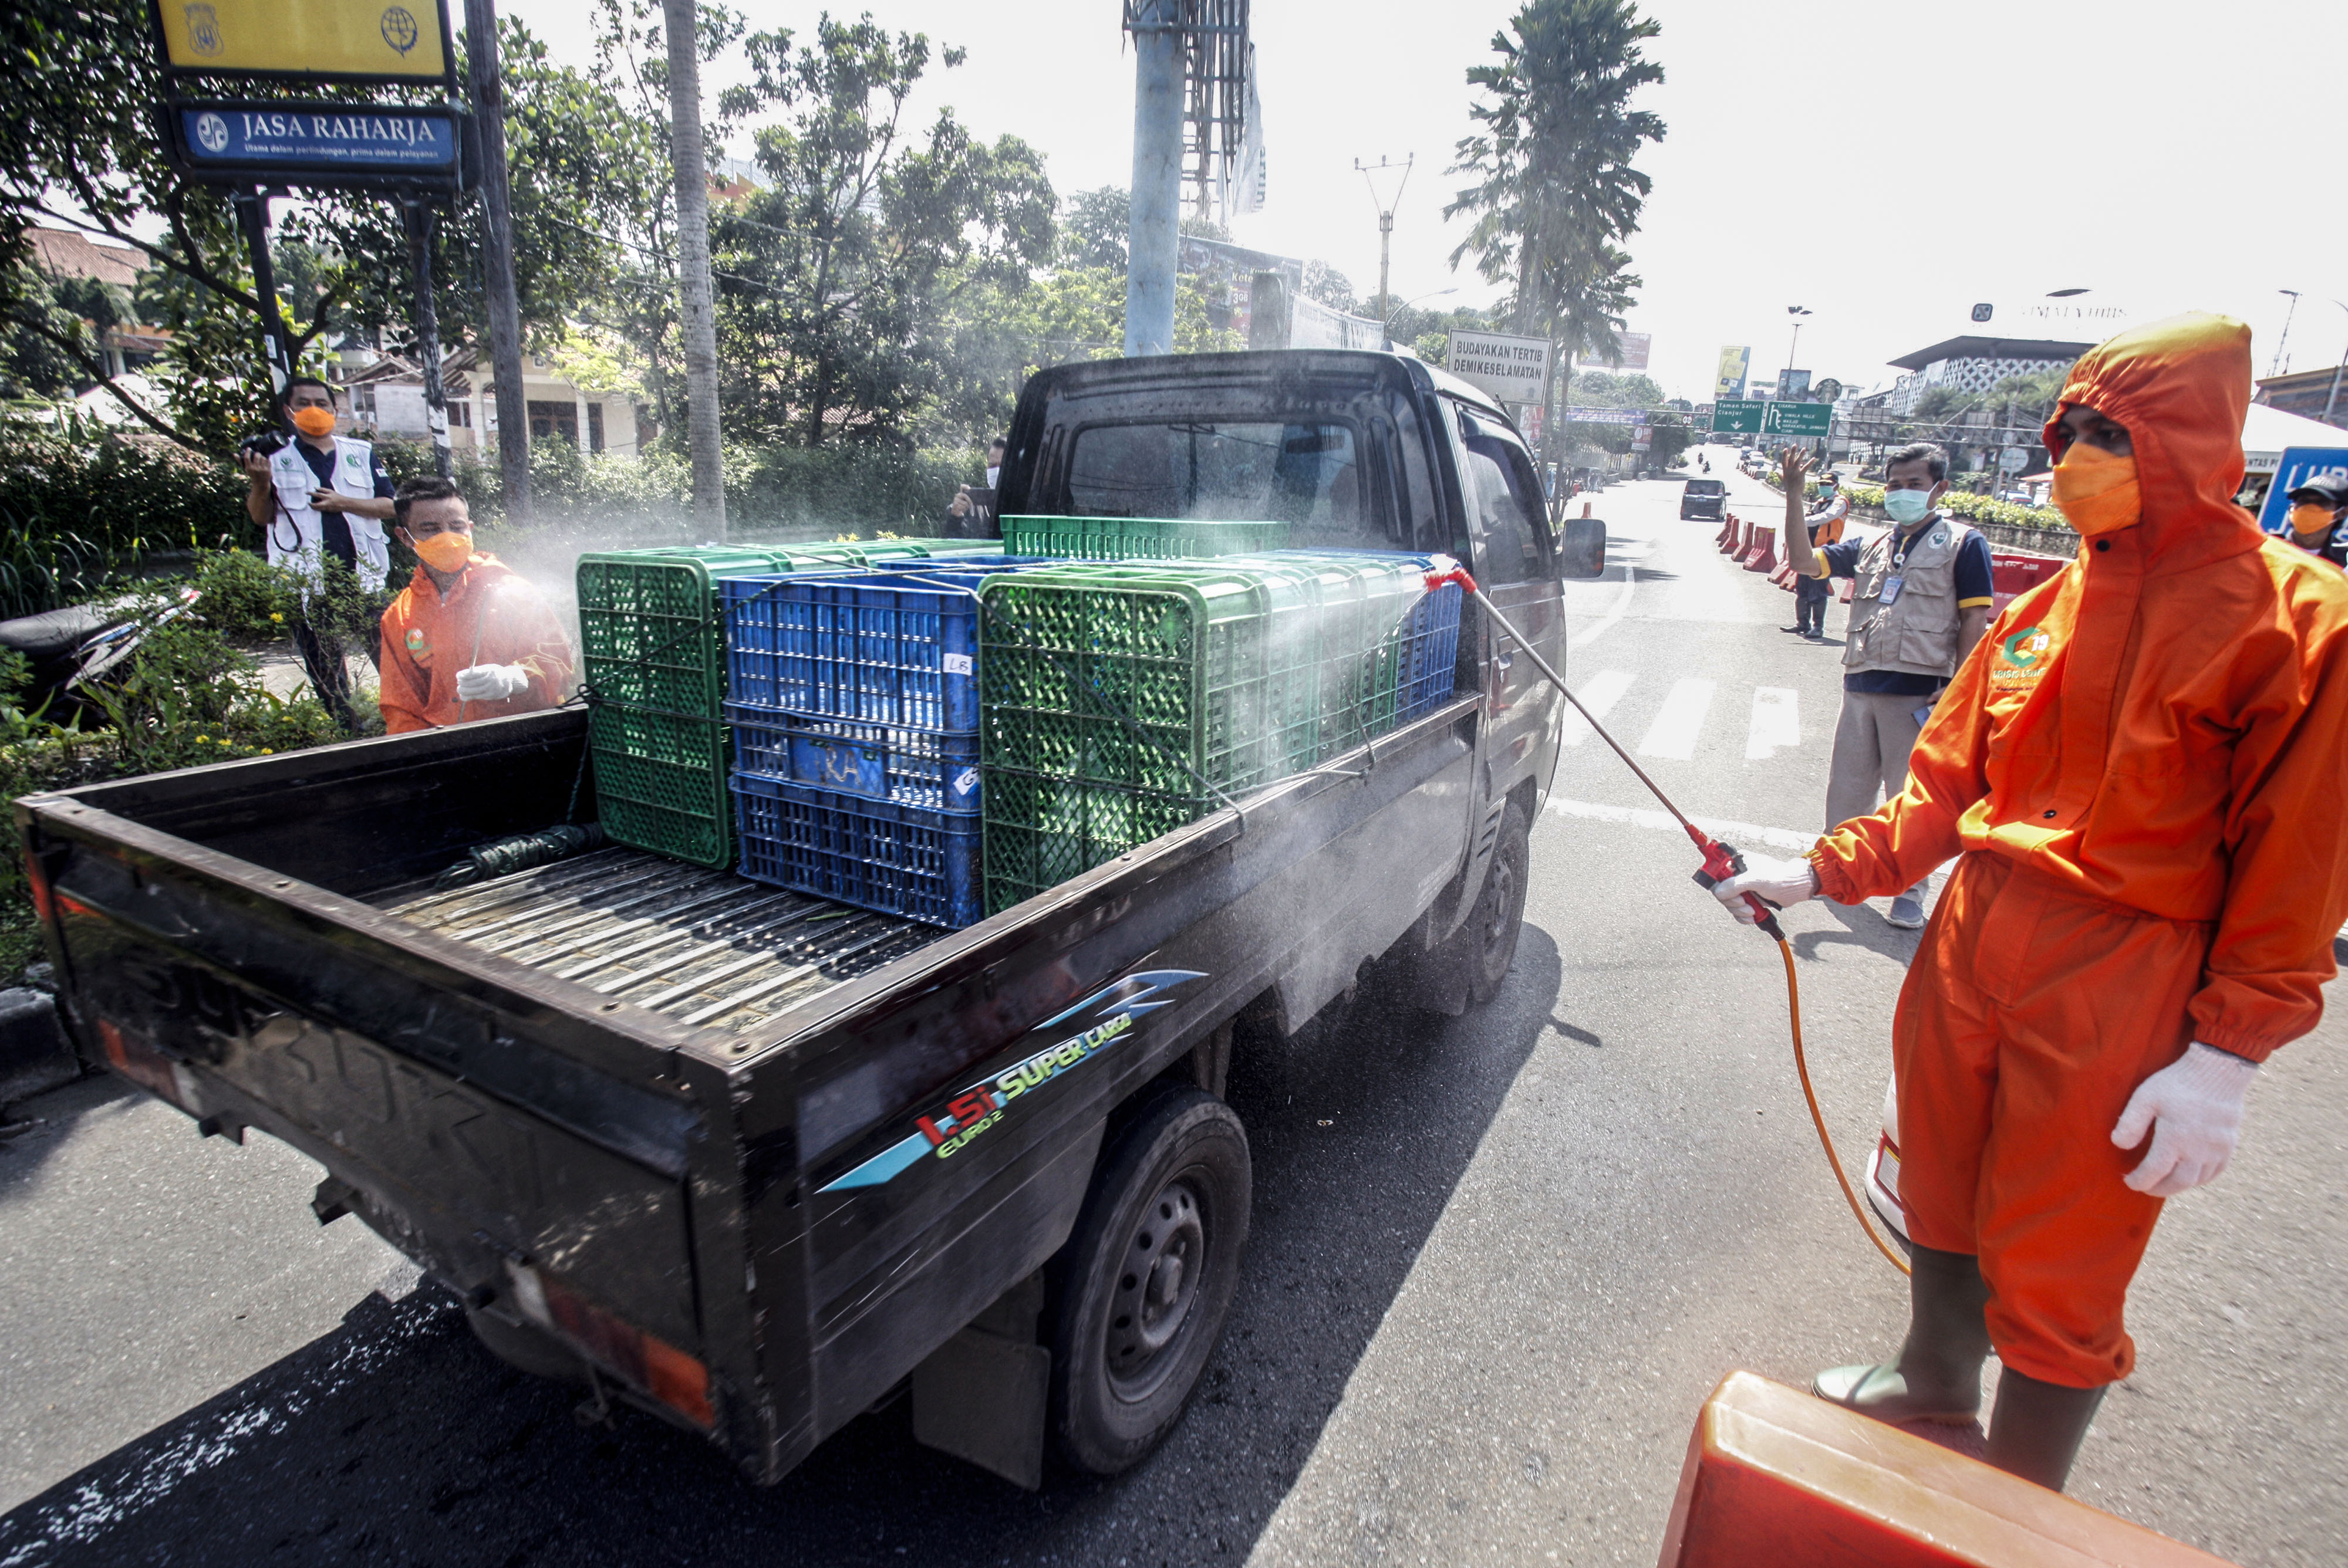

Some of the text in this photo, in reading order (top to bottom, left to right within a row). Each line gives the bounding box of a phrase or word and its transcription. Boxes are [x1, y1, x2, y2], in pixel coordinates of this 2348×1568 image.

[242, 113, 436, 147] JASA RAHARJA
[244, 143, 269, 153] Utama
[271, 144, 294, 154] dalam
[350, 147, 373, 159] prima
[375, 148, 398, 158] dalam
[399, 150, 438, 160] pelayanan
[1232, 272, 1253, 282] Kete
[1233, 293, 1248, 304] 3GB
[1456, 341, 1543, 362] BUDAYAKAN TERTIB
[2245, 458, 2268, 467] NTAS
[2031, 634, 2049, 652] 19
[996, 1038, 1086, 1101] SUPER
[1084, 1012, 1132, 1049] CARGO
